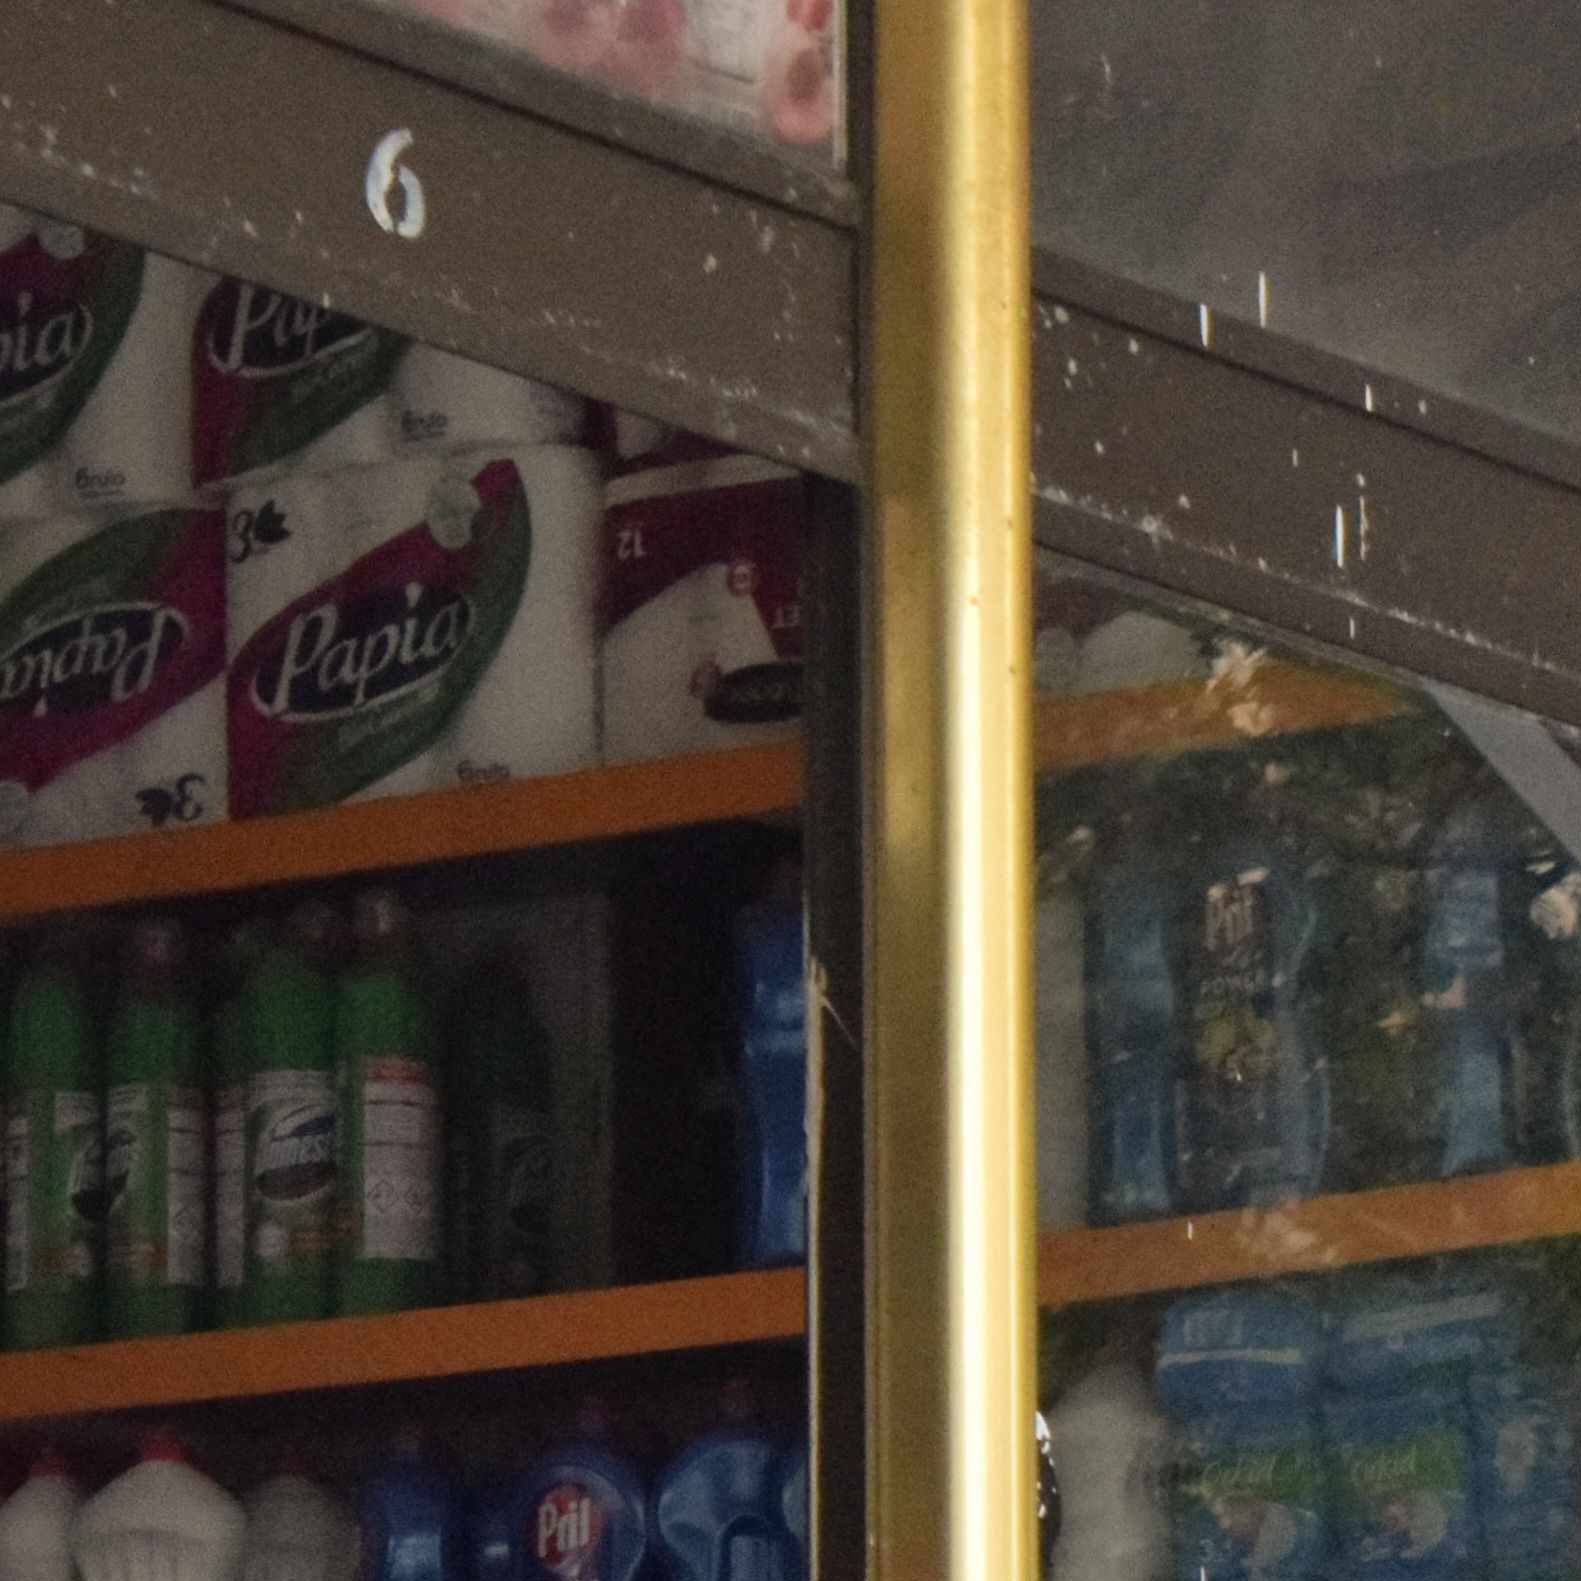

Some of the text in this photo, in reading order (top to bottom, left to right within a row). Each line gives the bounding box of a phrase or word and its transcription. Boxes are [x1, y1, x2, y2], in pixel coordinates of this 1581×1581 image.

[365, 128, 425, 238] 6
[251, 580, 475, 720] Papia
[538, 1498, 592, 1558] Pril
